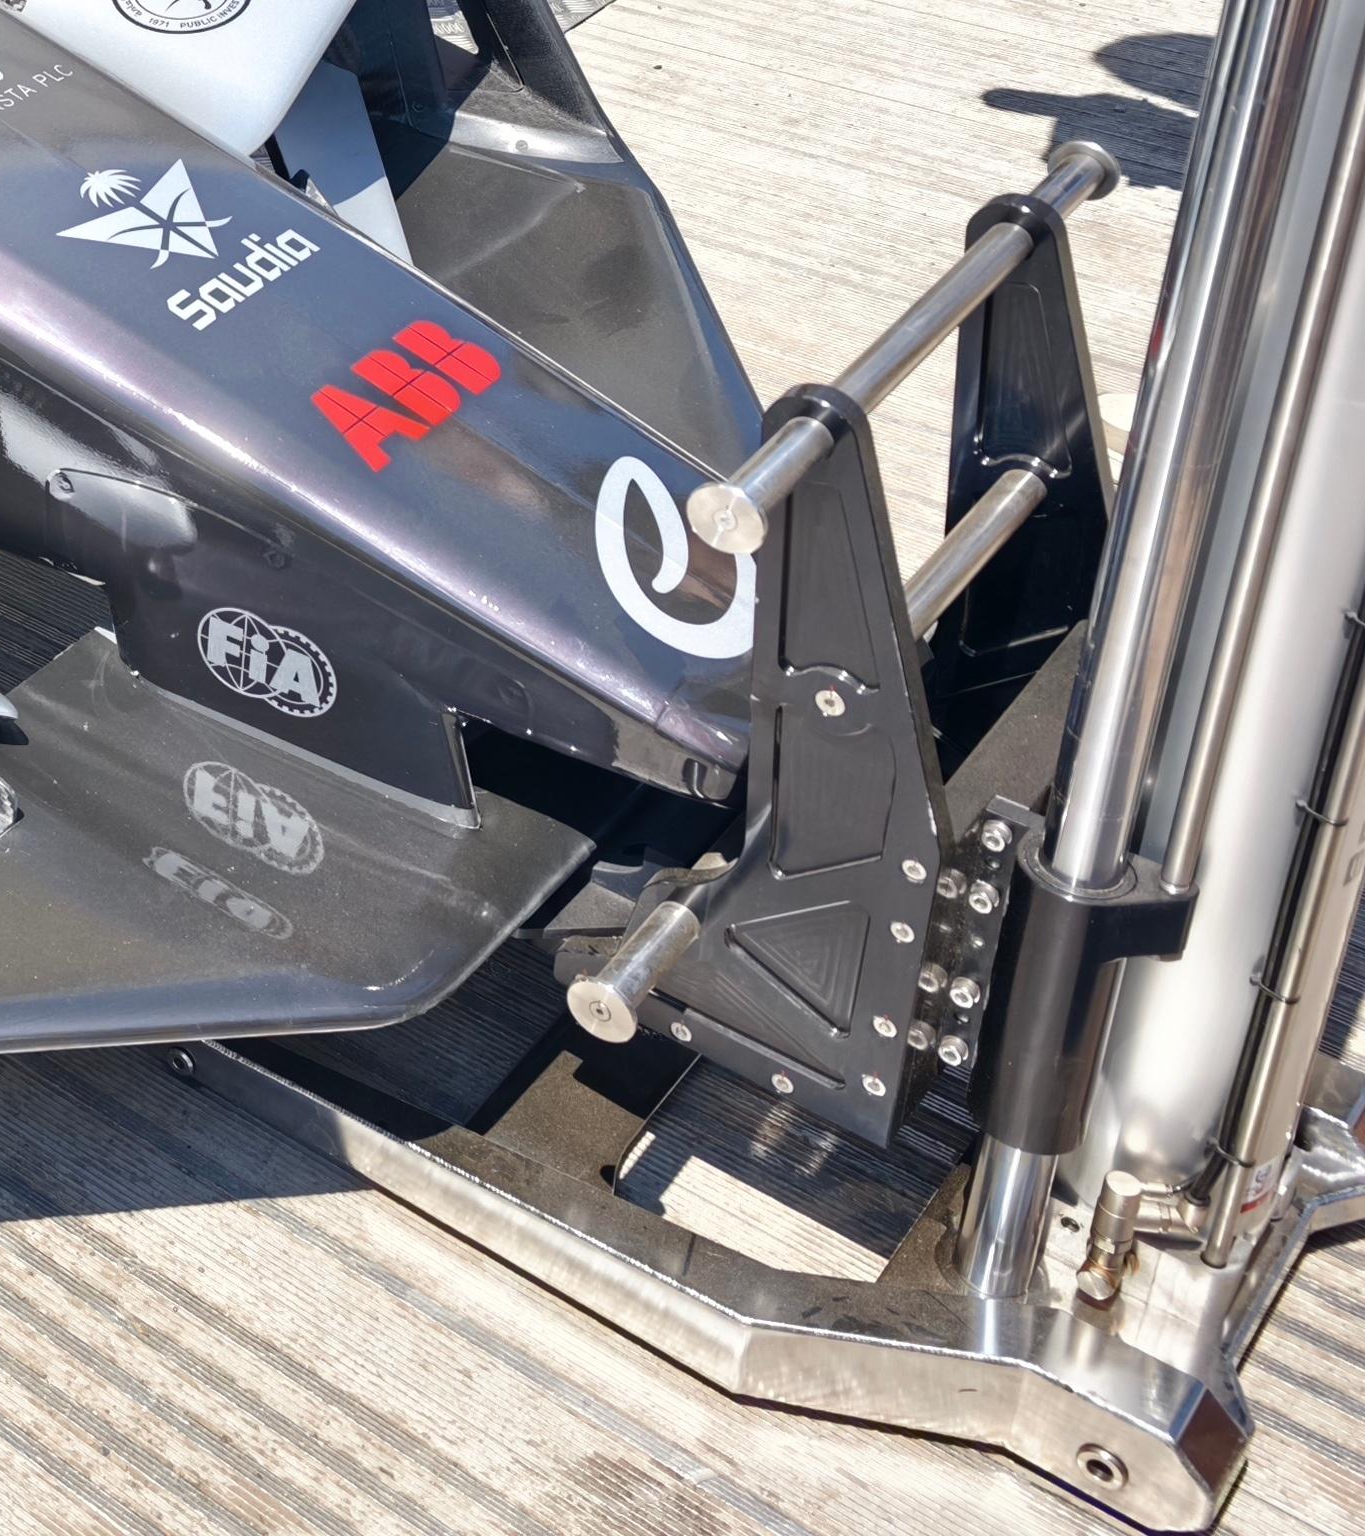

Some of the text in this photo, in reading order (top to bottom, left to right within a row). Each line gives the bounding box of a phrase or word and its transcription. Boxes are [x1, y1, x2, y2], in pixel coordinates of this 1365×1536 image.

[148, 17, 170, 28] 1971
[180, 16, 218, 29] PUBLIC
[32, 64, 74, 90] PLC
[167, 228, 321, 331] Saudia
[310, 319, 504, 473] ABB
